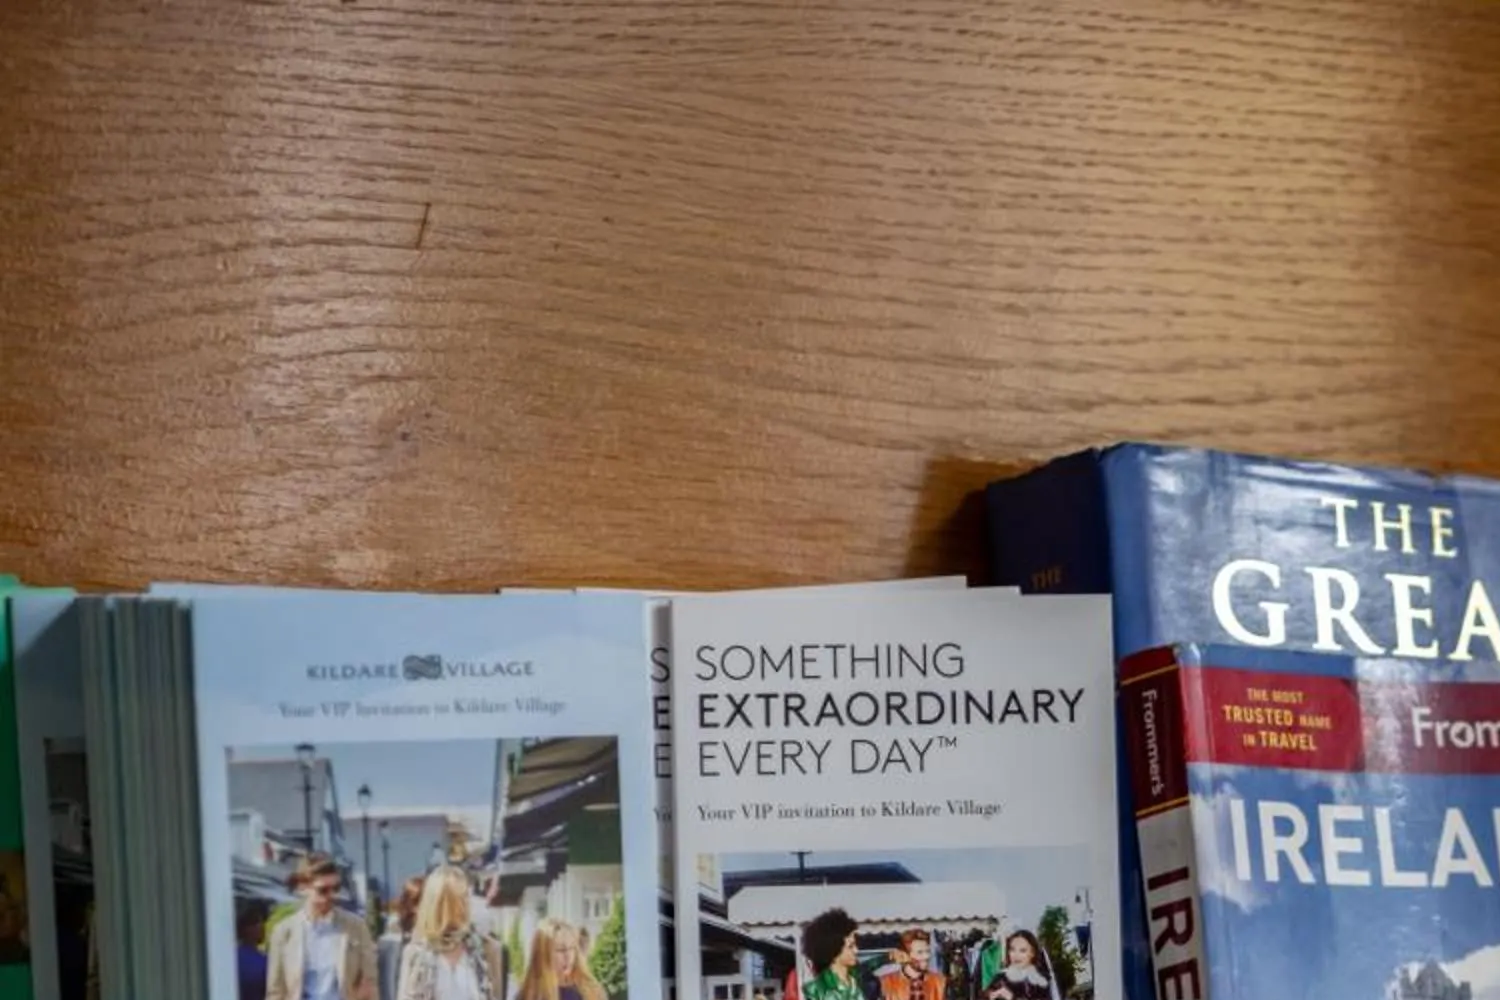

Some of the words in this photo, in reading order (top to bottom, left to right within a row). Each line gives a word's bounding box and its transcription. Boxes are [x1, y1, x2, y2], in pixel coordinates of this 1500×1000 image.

[1321, 497, 1457, 558] THE
[306, 664, 399, 680] KILDARE
[445, 660, 534, 677] VILLAGE
[695, 642, 965, 681] SOMETHING
[320, 702, 351, 716] VIP
[454, 698, 507, 714] Kildare
[515, 696, 567, 715] Village
[698, 688, 1085, 729] EXTRAORDINARY
[1246, 688, 1269, 701] THE
[1272, 690, 1303, 704] MOST
[1222, 704, 1294, 726] TRUSTED
[1300, 714, 1332, 730] NAME
[1142, 688, 1165, 796] Frommer's
[1243, 733, 1256, 747] IN
[1259, 730, 1317, 751] TRAVEL
[698, 740, 832, 777] EVERY
[697, 805, 736, 821] Your
[741, 804, 773, 819] VIP
[777, 803, 855, 819] invitation
[860, 806, 877, 818] to
[881, 801, 942, 817] Kildare
[946, 799, 1002, 821] Village
